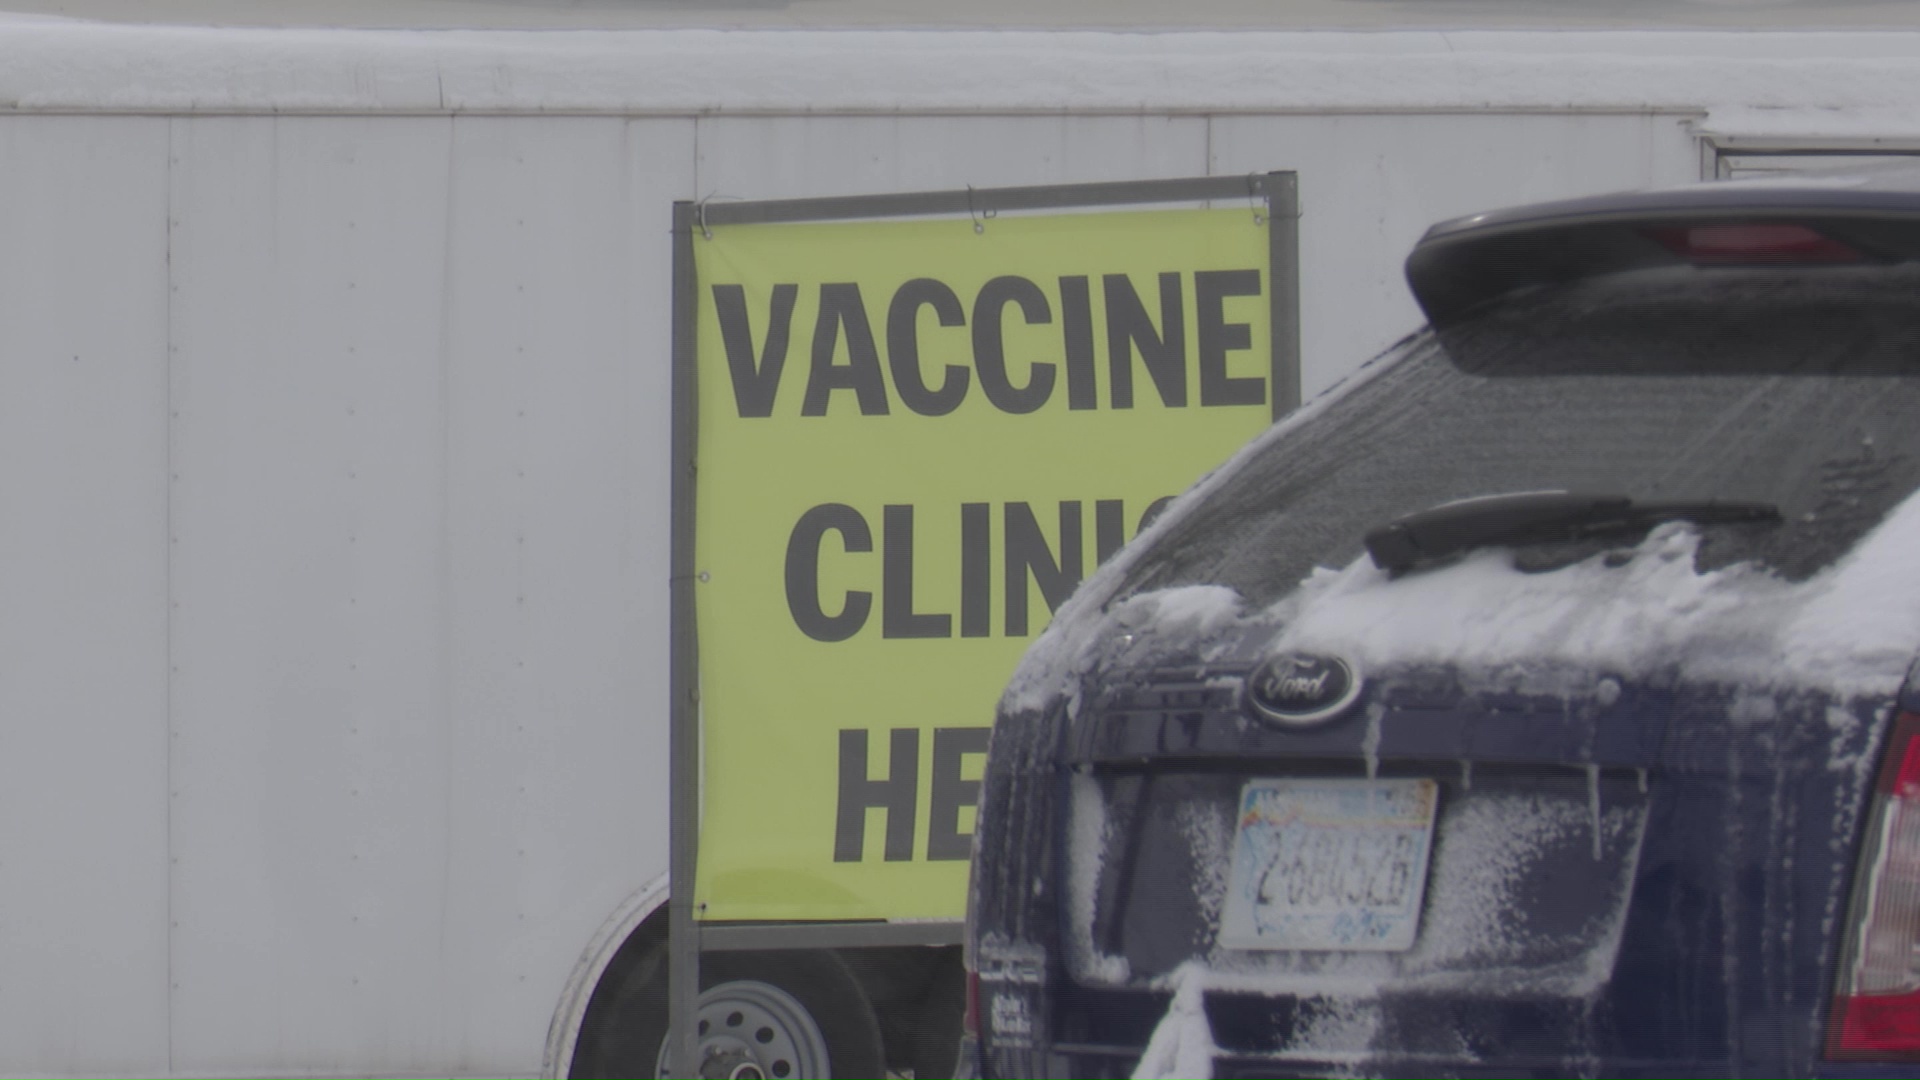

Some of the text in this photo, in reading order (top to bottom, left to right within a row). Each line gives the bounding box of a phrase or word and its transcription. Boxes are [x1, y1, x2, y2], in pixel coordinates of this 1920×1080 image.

[711, 269, 1267, 418] VACCINE
[784, 496, 1179, 643] CLIN
[1265, 654, 1330, 700] Ford
